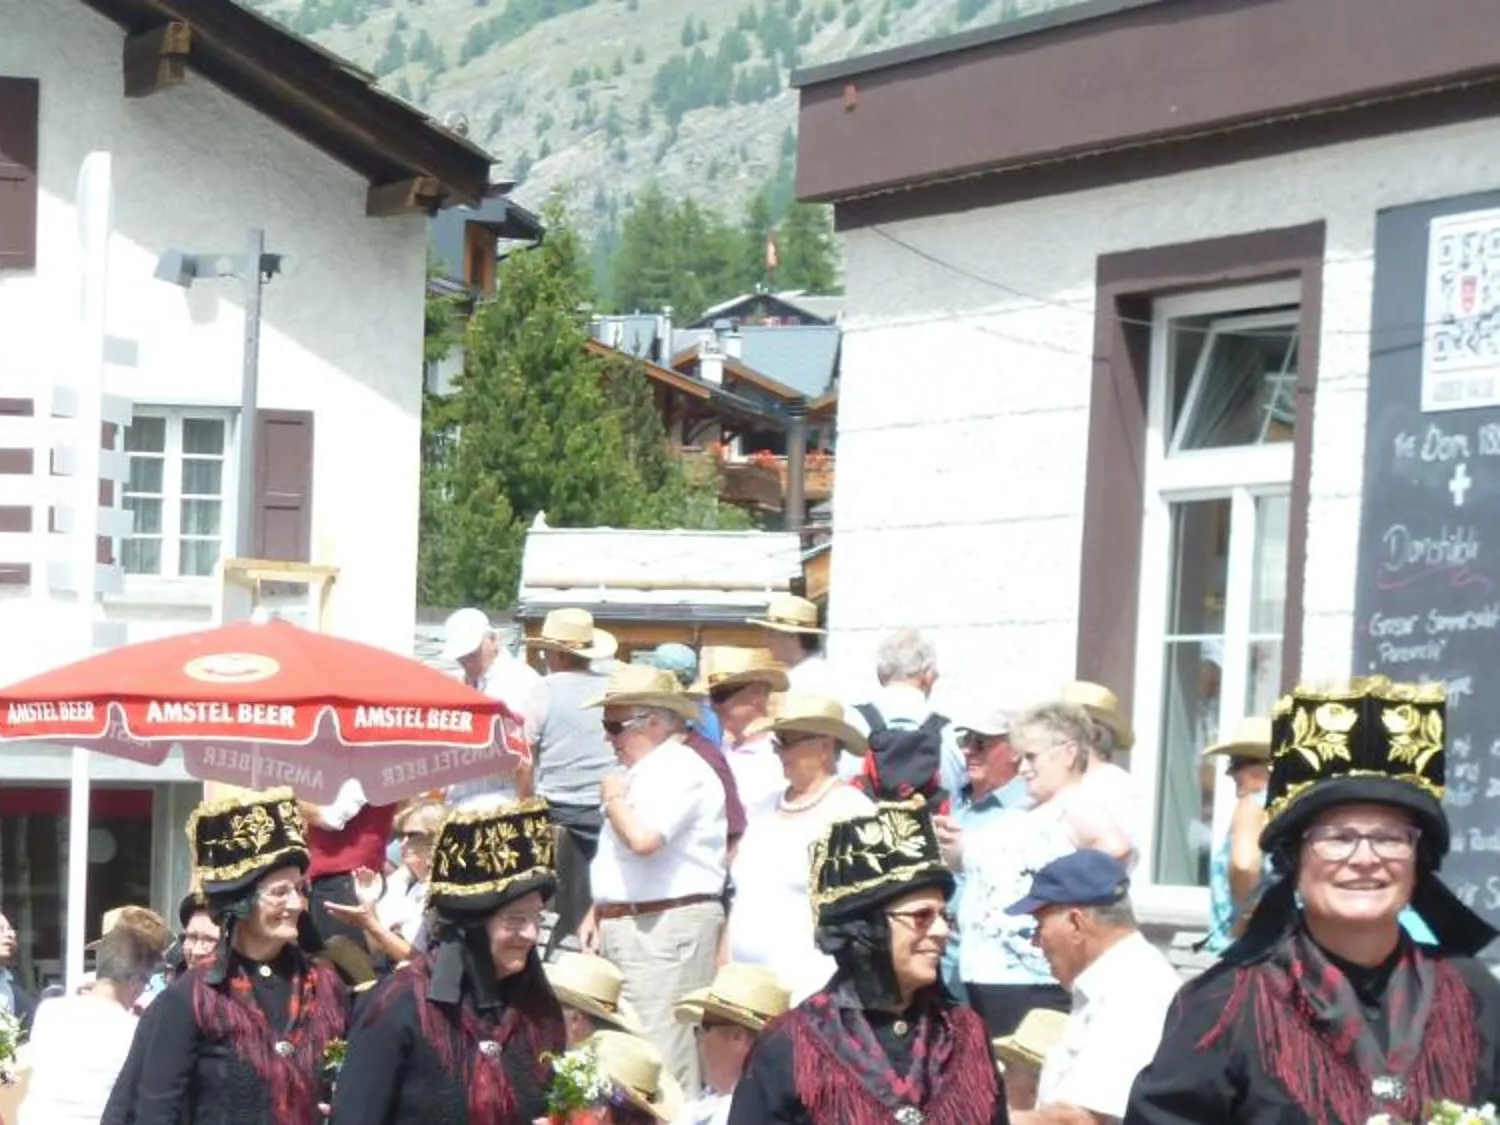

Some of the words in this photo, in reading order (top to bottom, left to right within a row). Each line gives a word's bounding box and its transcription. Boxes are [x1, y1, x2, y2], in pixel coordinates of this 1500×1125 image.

[7, 703, 59, 724] AMSTEL
[60, 702, 95, 722] BEER
[146, 701, 233, 723] AMSTEL
[237, 704, 296, 727] BEER
[354, 705, 424, 728] AMSTEL
[426, 709, 474, 733] BEER
